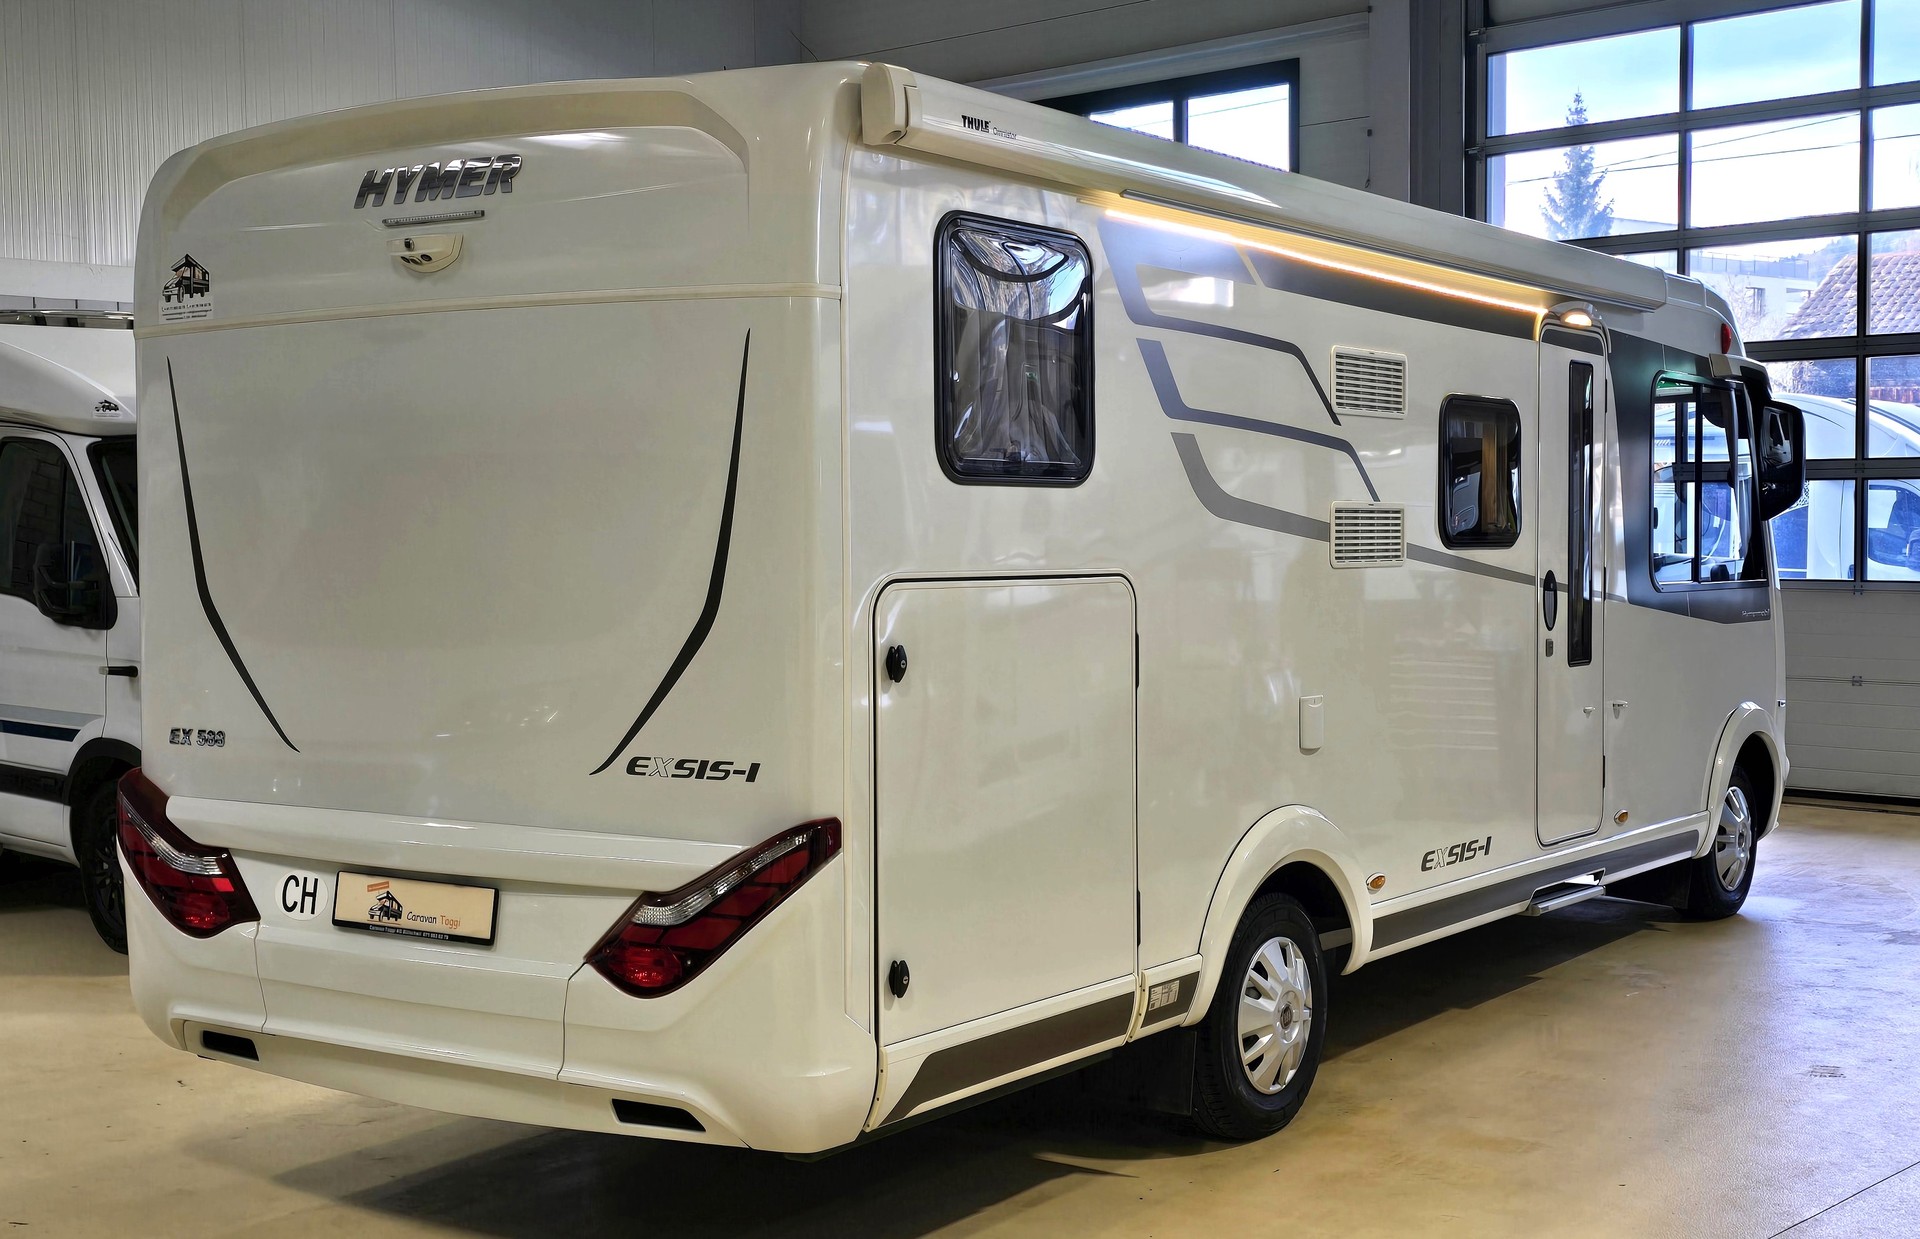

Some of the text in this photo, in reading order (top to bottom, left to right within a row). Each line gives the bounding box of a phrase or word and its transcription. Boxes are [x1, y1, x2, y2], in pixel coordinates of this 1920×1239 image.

[961, 115, 990, 133] THULE
[354, 154, 522, 209] HYMER
[169, 728, 193, 746] EX
[626, 756, 761, 783] EXSIS-I
[1421, 836, 1492, 872] EXSIS-I
[282, 874, 319, 915] CH
[406, 911, 461, 930] Caravan Toggi
